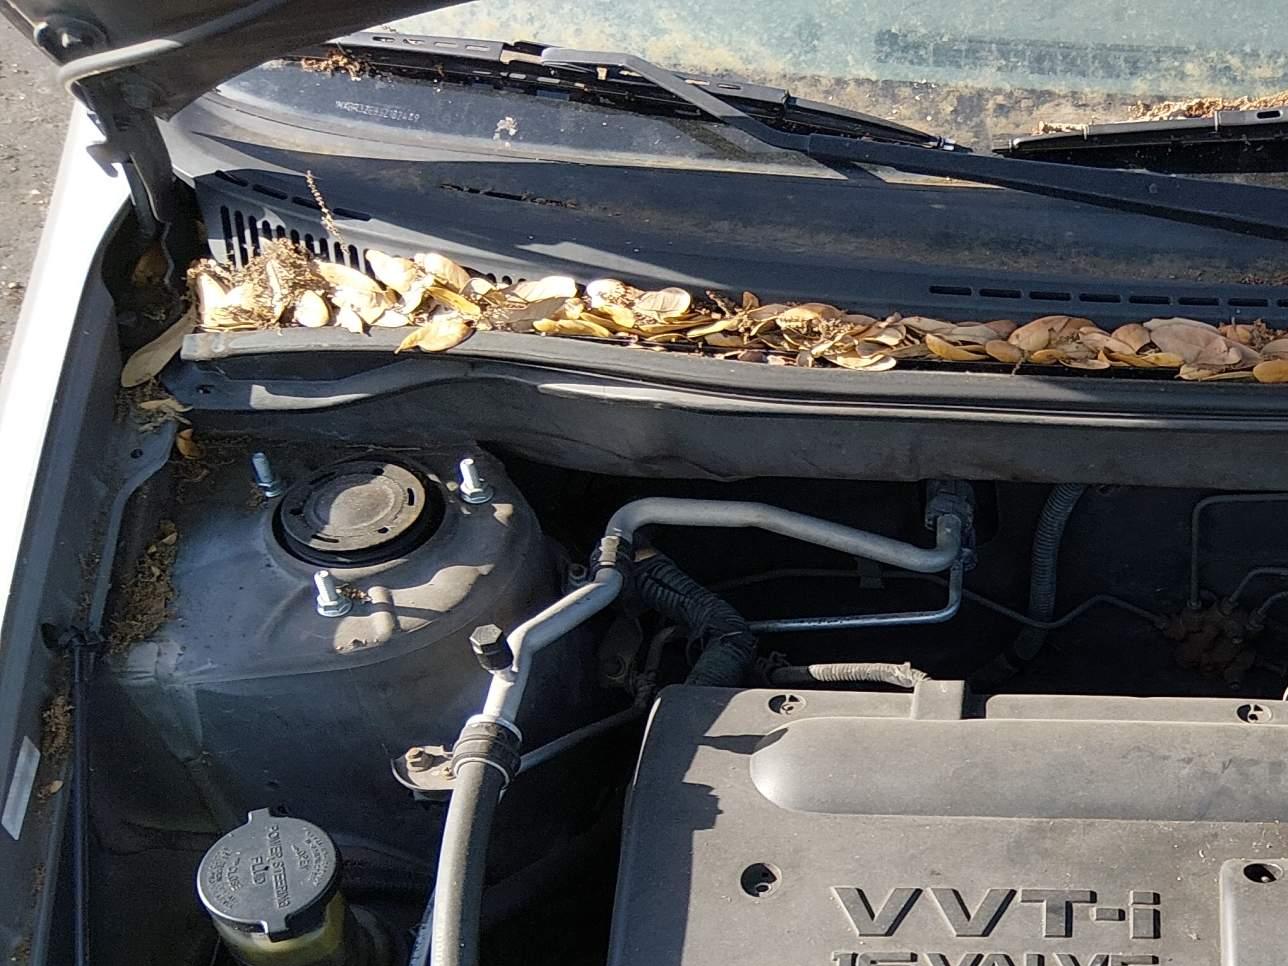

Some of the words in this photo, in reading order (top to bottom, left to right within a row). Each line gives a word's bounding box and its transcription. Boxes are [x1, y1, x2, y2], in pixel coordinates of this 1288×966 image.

[267, 825, 283, 859] POWER
[250, 856, 267, 885] FLUID
[270, 860, 291, 909] STEERING
[830, 886, 1161, 939] VVT-i
